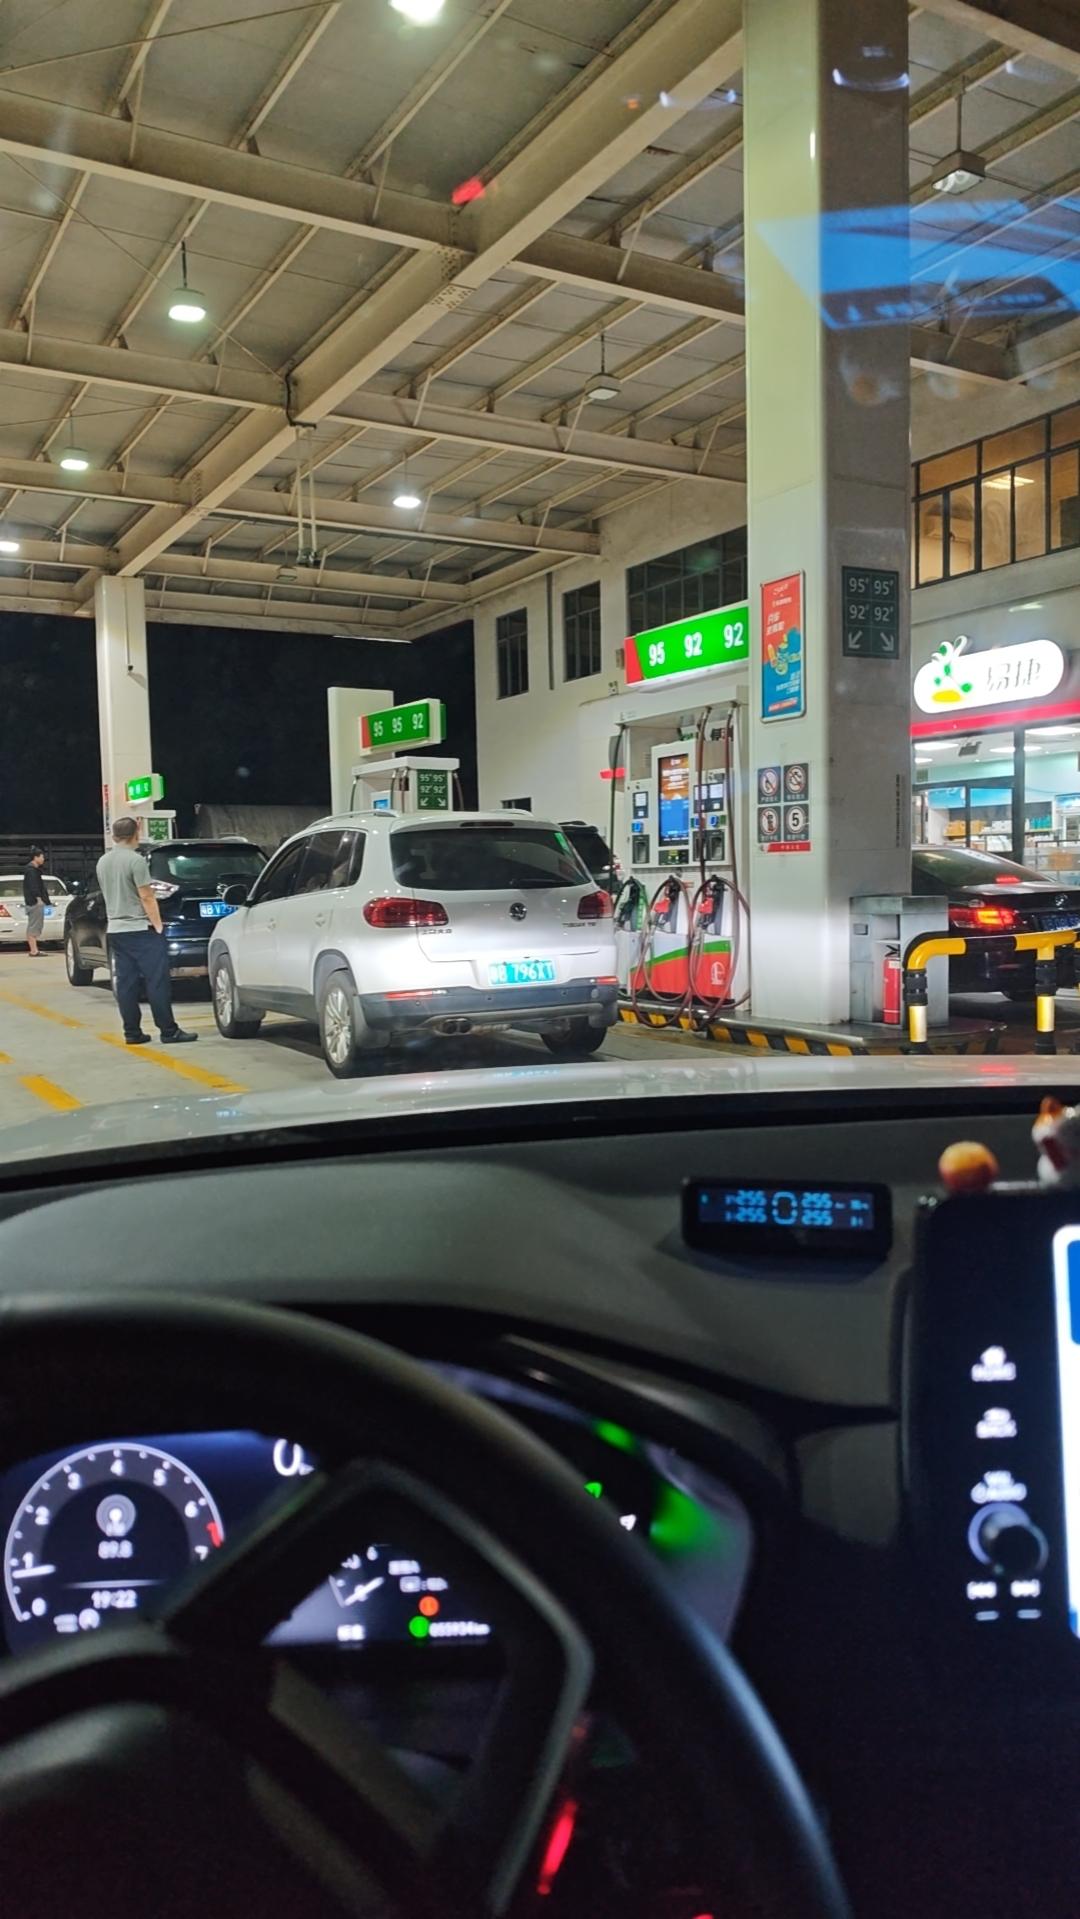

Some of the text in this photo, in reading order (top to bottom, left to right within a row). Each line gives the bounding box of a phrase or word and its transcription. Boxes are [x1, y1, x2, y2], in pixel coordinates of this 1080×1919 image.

[648, 641, 665, 667] 95
[684, 631, 703, 658] 92
[723, 622, 744, 648] 92
[373, 713, 423, 737] 95 95 92
[792, 812, 800, 827] 5
[110, 1458, 124, 1477] 4
[67, 1472, 81, 1490] 3
[153, 1468, 167, 1487] 5
[35, 1506, 49, 1526] 2
[184, 1501, 198, 1518] 6
[31, 1597, 46, 1617] 0
[91, 1590, 137, 1609] 19:22
